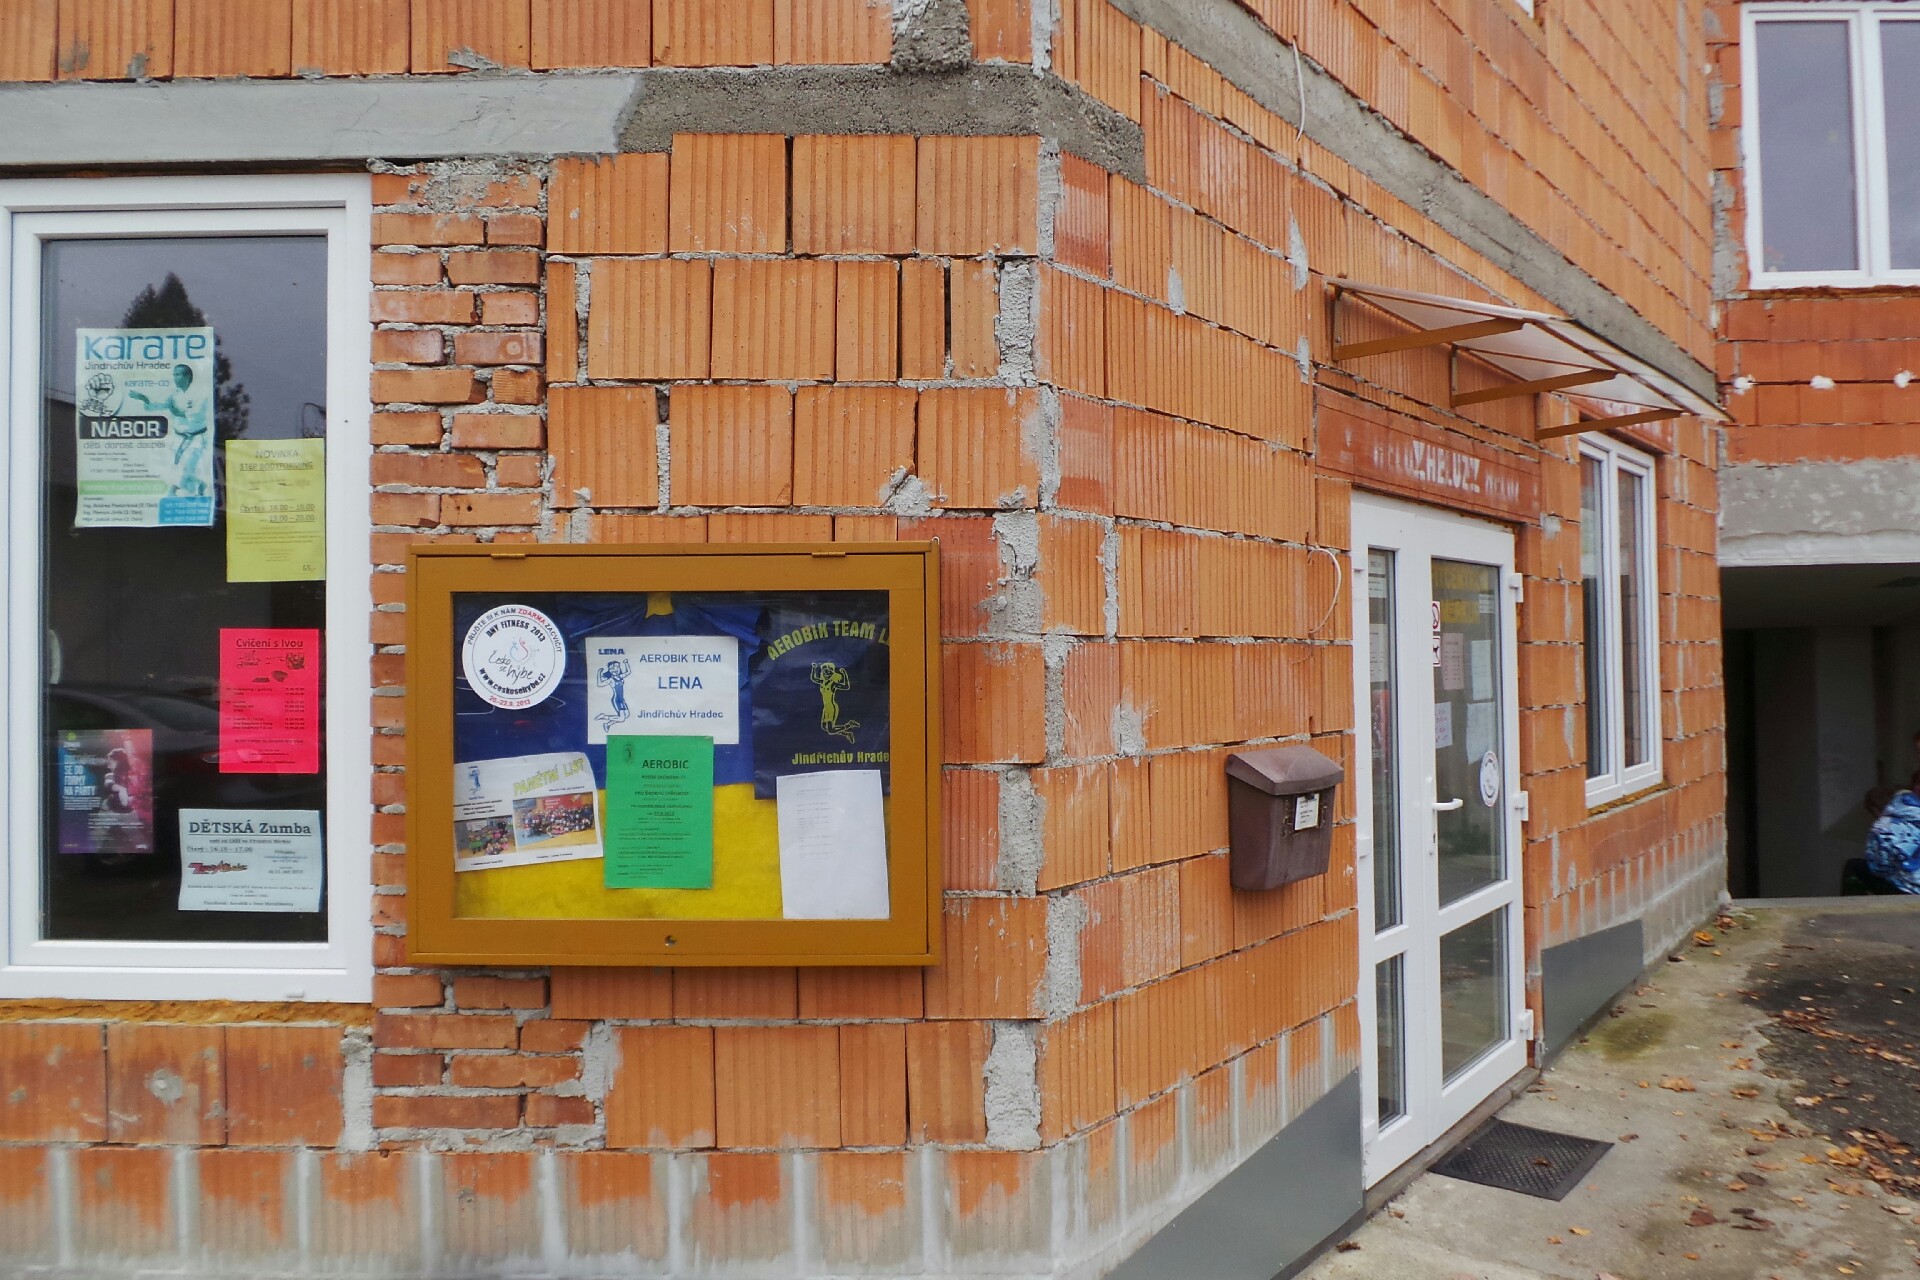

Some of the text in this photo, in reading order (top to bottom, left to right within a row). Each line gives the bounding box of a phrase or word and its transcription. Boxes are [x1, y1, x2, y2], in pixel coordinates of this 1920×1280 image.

[136, 361, 171, 370] Hradec
[90, 417, 161, 438] NÁBOR
[255, 449, 299, 459] NOVINKA
[239, 462, 258, 471] STEP
[467, 620, 486, 645] PŘIJĎTE
[500, 607, 517, 615] NÁM
[517, 608, 546, 625] ZDARMA
[544, 623, 563, 653] ZACVIČIT
[485, 619, 546, 643] DNY FITNESS 2013
[236, 638, 304, 648] Cvičení s Ivou
[767, 621, 829, 661] AEROBIK
[832, 620, 876, 640] TEAM
[639, 654, 722, 663] AEROBIK TEAM
[479, 667, 546, 695] www.ceskosehybe.cz
[658, 676, 703, 690] LENA
[637, 709, 724, 719] Jindřichův Hradec
[791, 750, 854, 765] Jindřichův
[641, 759, 690, 769] AEROBIC
[74, 786, 96, 796] PARTY
[188, 818, 312, 834] DĚTSKÁ Zumba
